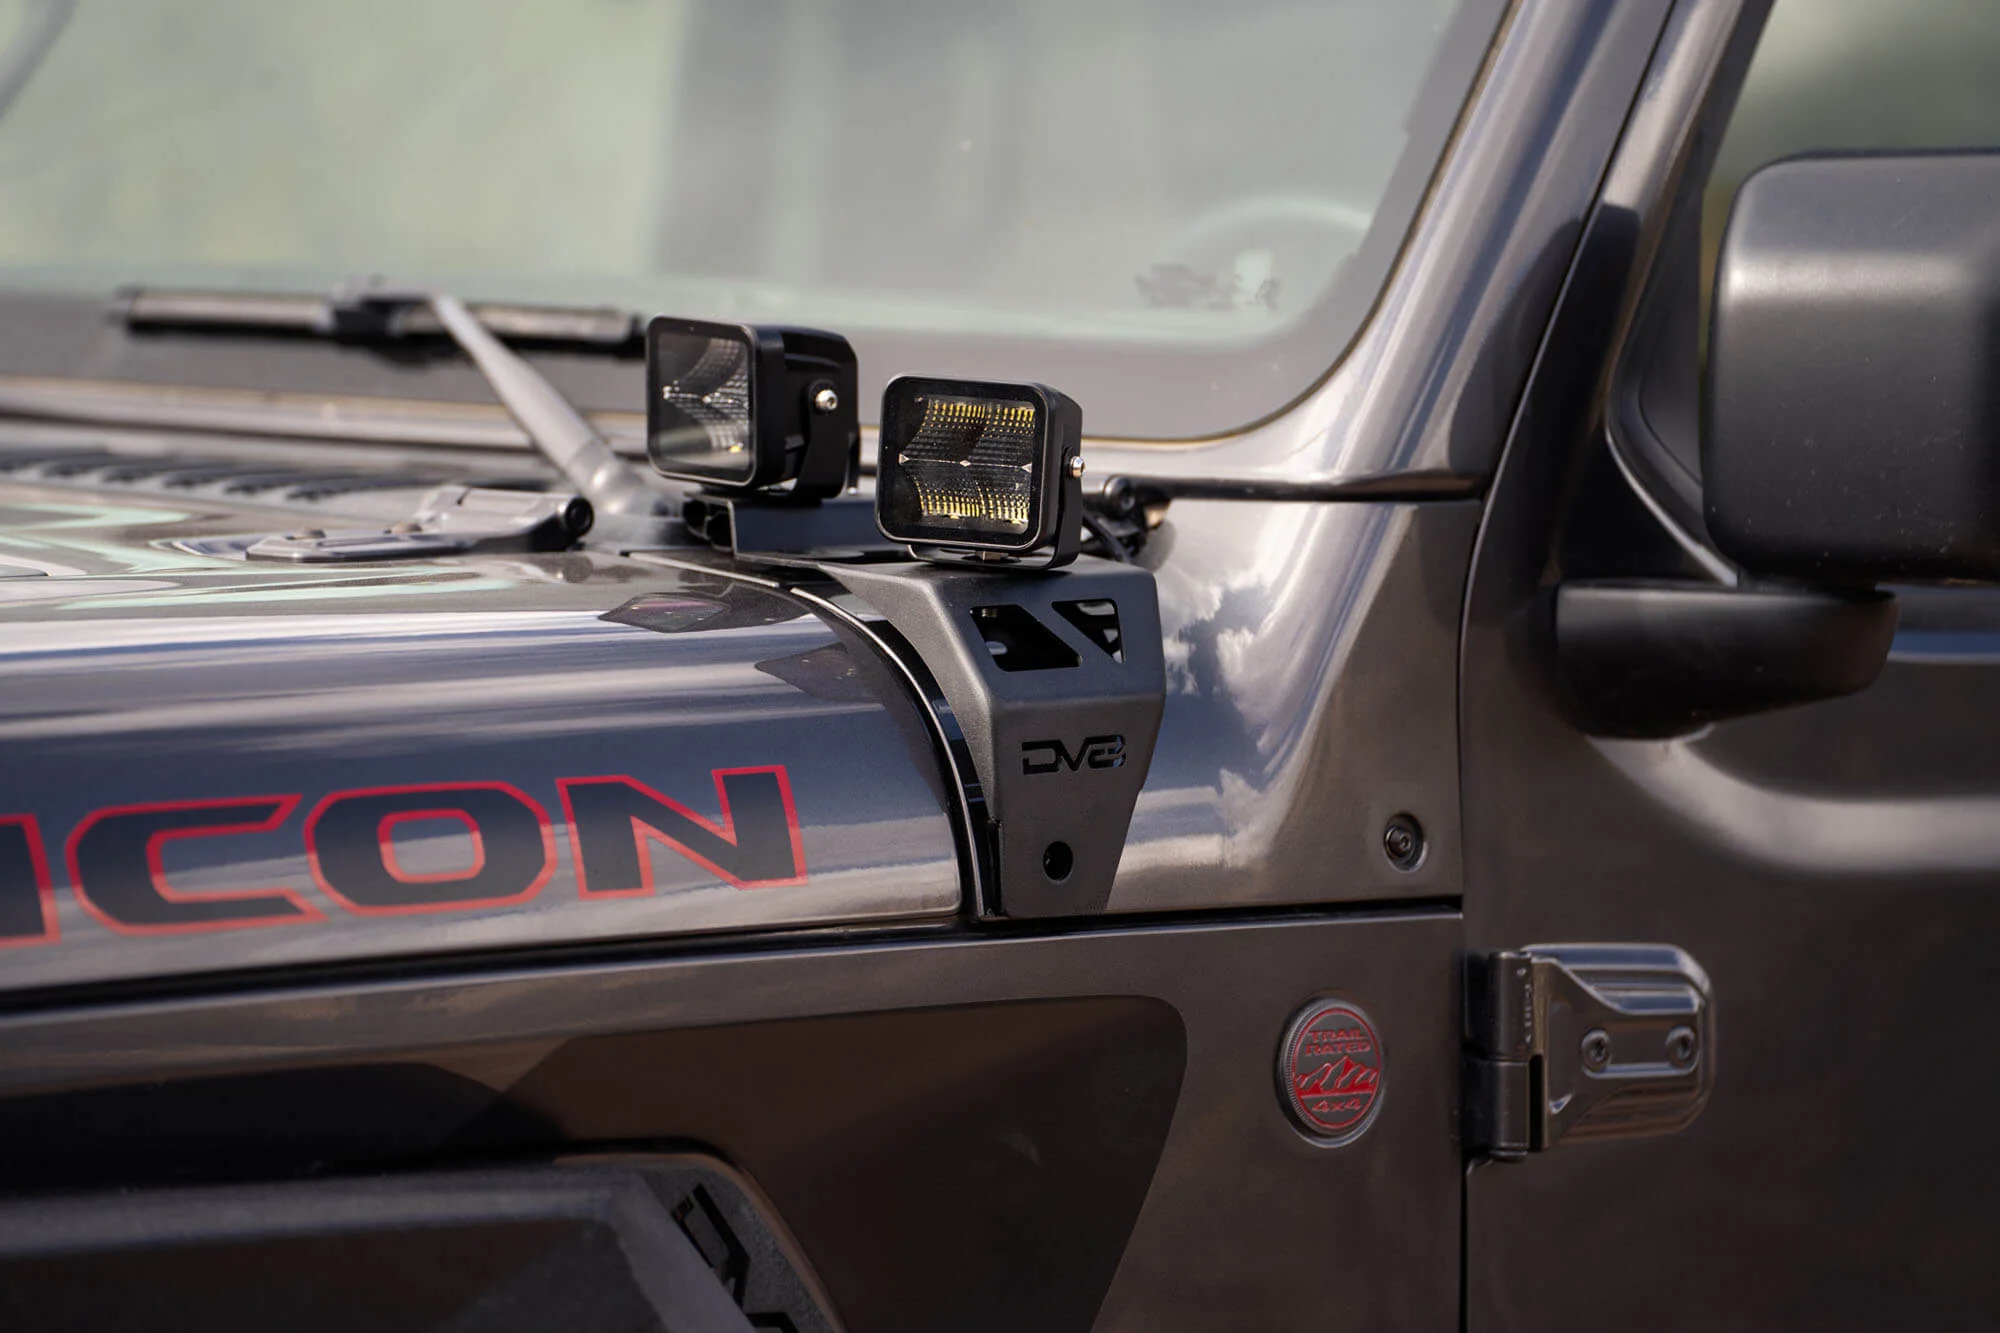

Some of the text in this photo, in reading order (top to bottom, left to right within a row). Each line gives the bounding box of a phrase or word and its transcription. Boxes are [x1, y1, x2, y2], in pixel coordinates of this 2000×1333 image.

[1021, 734, 1127, 775] DV8
[1309, 1028, 1367, 1043] TRAIL
[1305, 1041, 1371, 1056] RATED
